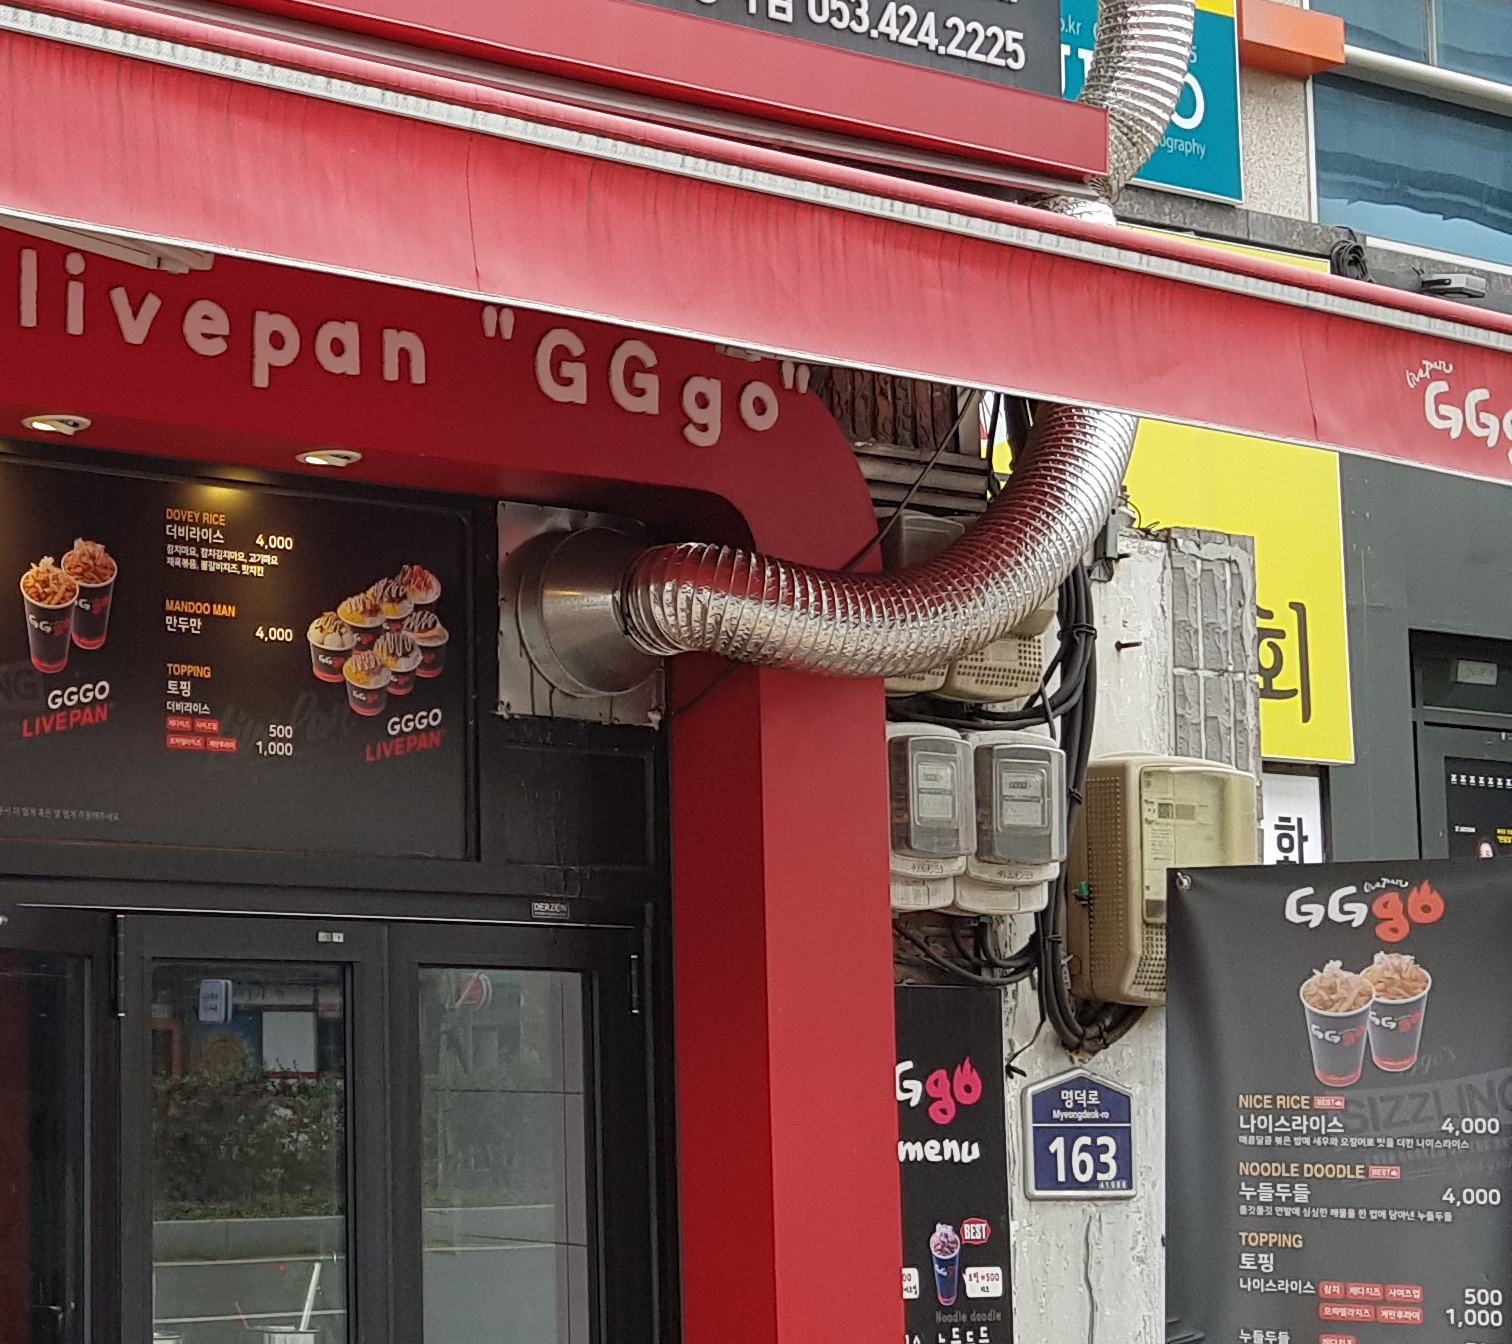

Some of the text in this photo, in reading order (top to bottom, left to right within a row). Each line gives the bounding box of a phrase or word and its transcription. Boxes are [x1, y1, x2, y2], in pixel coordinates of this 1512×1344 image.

[18, 247, 428, 389] livepan
[166, 508, 226, 526] DOVEY RICE
[166, 524, 293, 550] 더비라이스 4,000
[165, 599, 236, 617] MANDOO MAN
[165, 616, 293, 642] 만두만 4,000
[166, 663, 211, 679] TOPPING
[46, 680, 111, 710] GGGO
[166, 680, 191, 697] 토핑
[166, 701, 210, 714] 더비라이스
[21, 706, 109, 739] LIVEPAN
[269, 724, 293, 738] 500
[387, 708, 442, 736] GGGO
[256, 741, 293, 756] 1,000
[365, 729, 441, 763] LIVEPAN
[1061, 1089, 1100, 1109] 명덕로
[1239, 1094, 1273, 1109] NICE
[1276, 1095, 1310, 1109] RICE
[1239, 1114, 1500, 1136] 나이스라이스 4,000
[898, 1140, 980, 1164] menu
[1048, 1136, 1117, 1183] 163
[1239, 1162, 1299, 1177] NOODLE
[1303, 1164, 1365, 1179] DOODLE
[1239, 1182, 1501, 1206] 누들두들 4,000
[964, 1223, 986, 1240] BEST
[1239, 1231, 1303, 1249] TOPPING
[1239, 1253, 1274, 1273] 토핑
[1239, 1277, 1316, 1294] 나이스라이스
[1464, 1288, 1503, 1306] 500
[1445, 1308, 1503, 1328] 1,000
